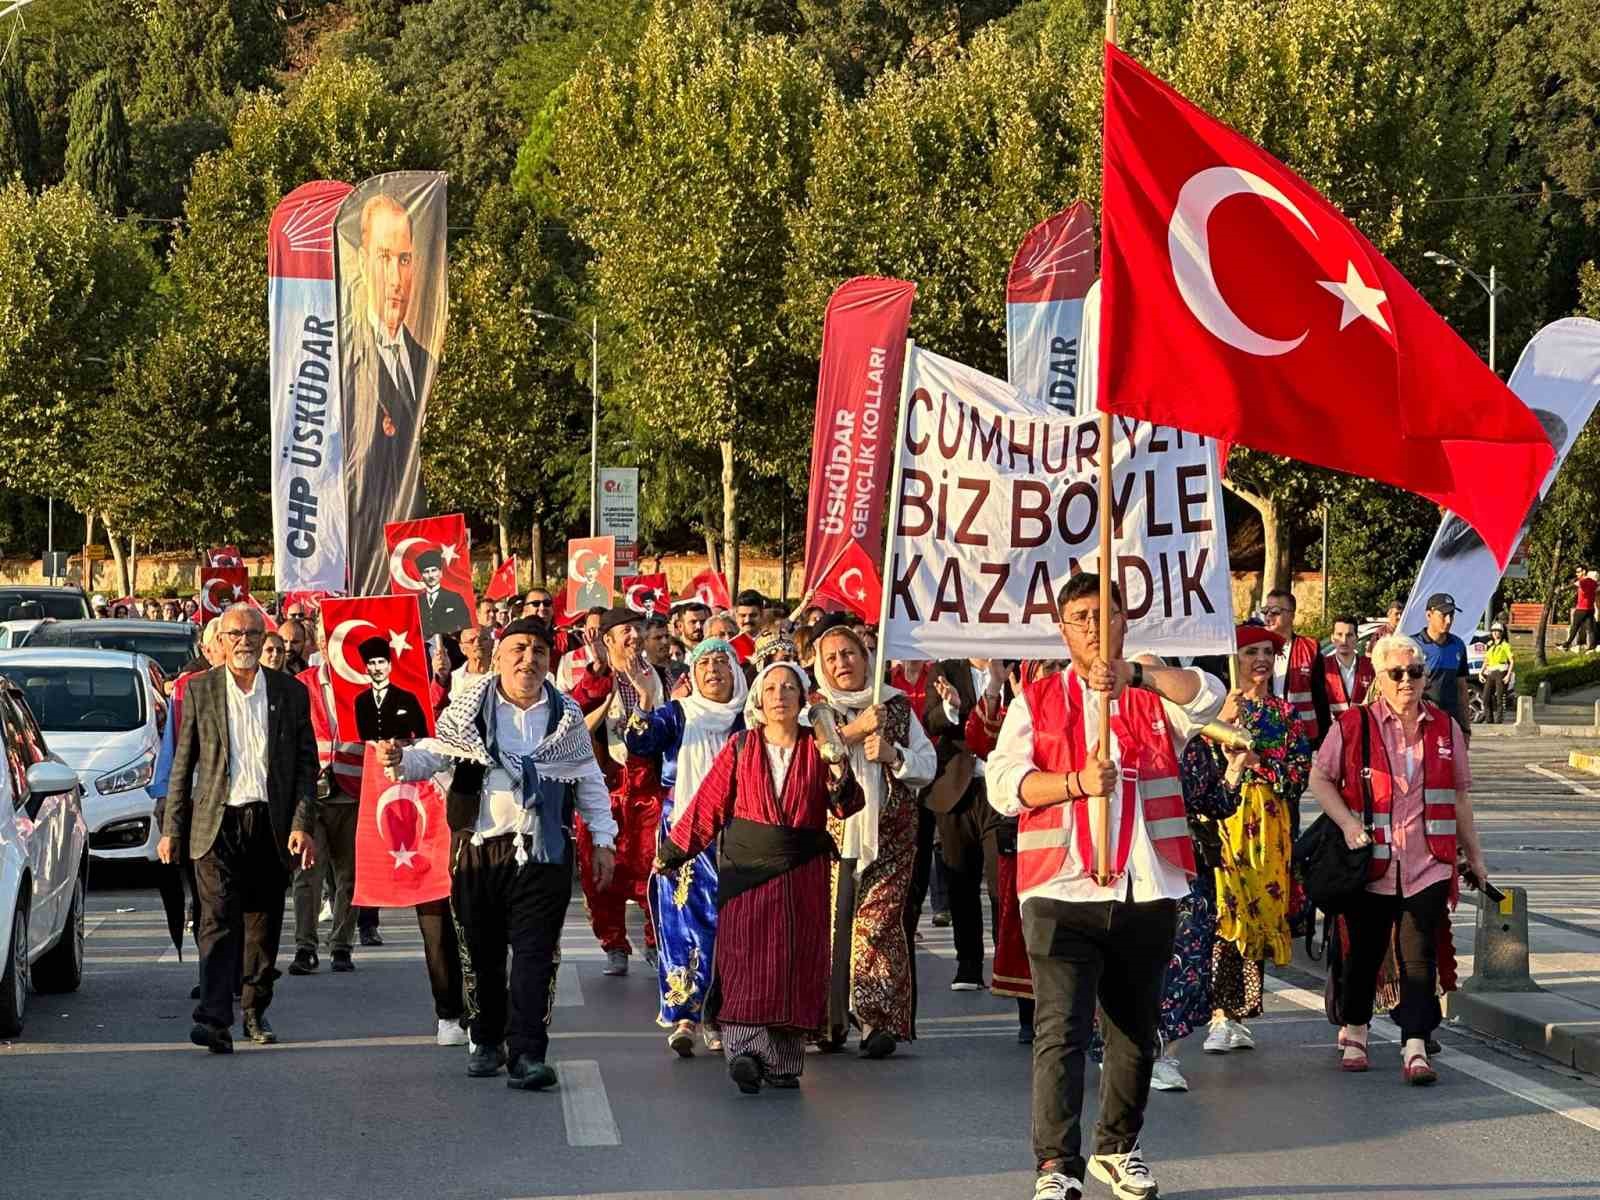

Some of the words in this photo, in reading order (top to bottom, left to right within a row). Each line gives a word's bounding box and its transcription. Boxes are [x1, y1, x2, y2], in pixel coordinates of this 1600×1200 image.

[282, 314, 335, 469] ÜSKÜDAR
[861, 347, 887, 441] KOLLARI
[287, 476, 317, 559] CHP
[819, 408, 856, 535] ÜSKÜDAR
[850, 444, 877, 540] GENÇLİK
[1010, 463, 1213, 548] BÖYLE
[888, 548, 1216, 624] KAZADIK
